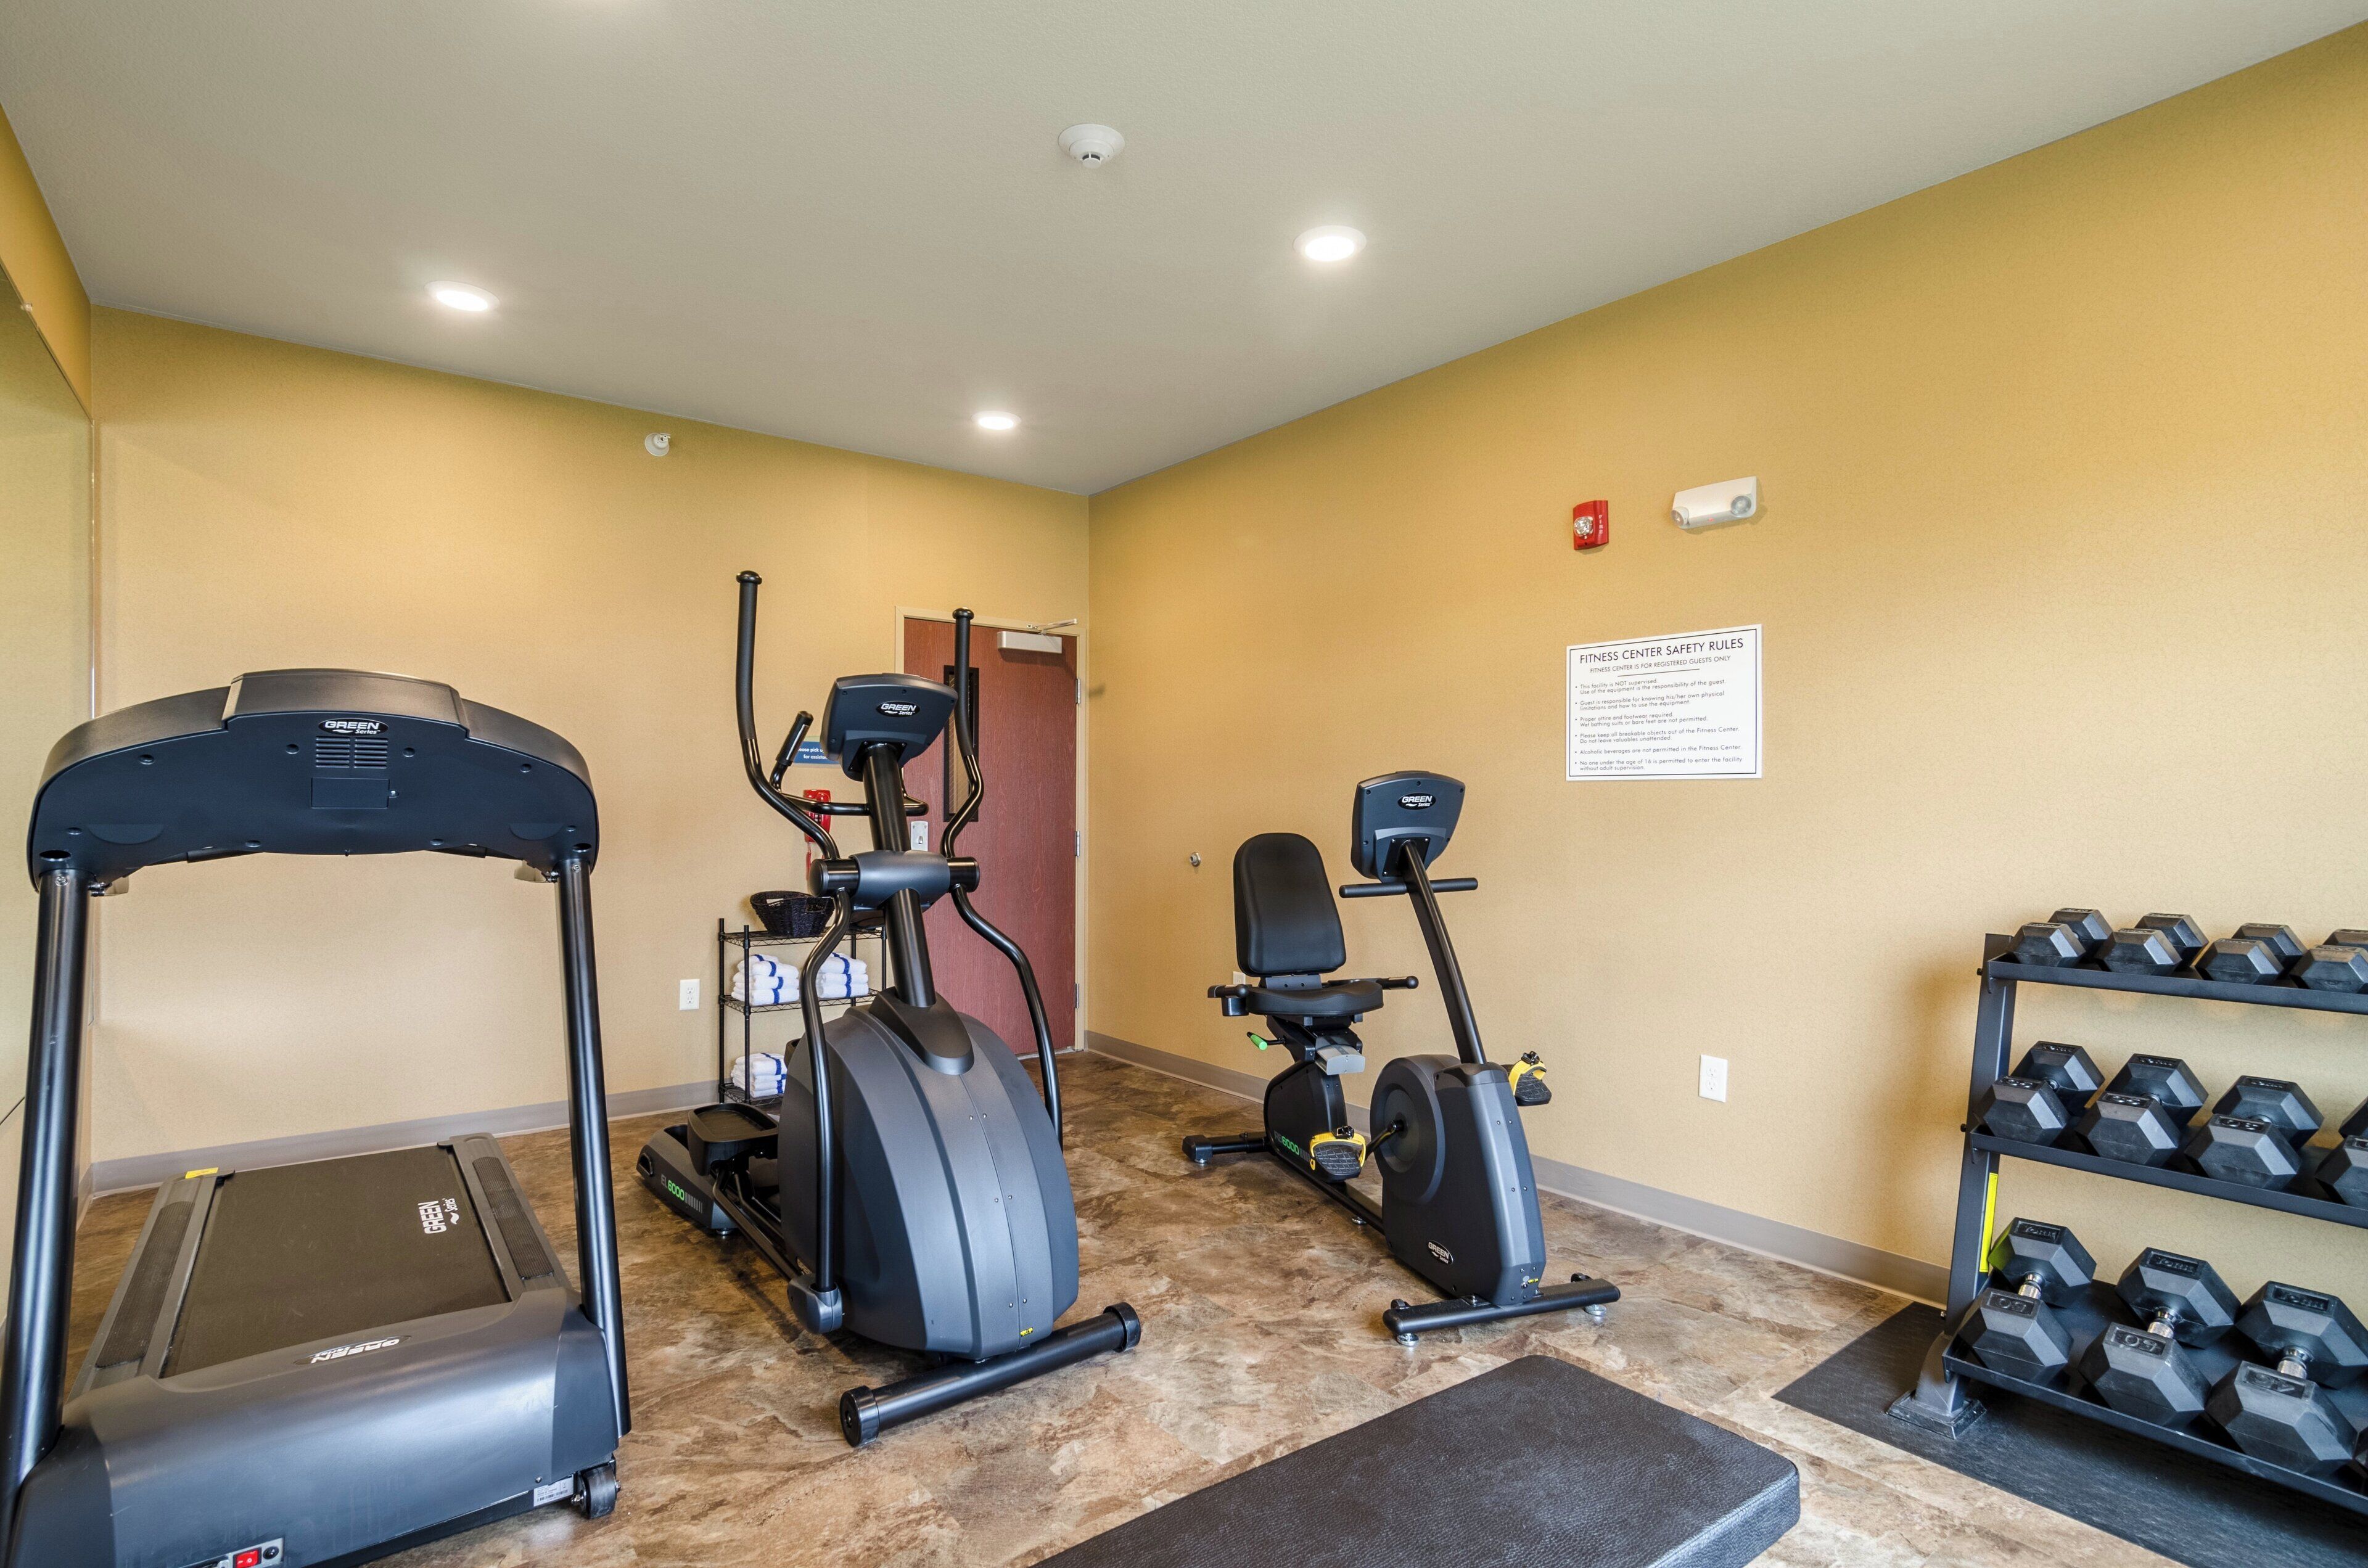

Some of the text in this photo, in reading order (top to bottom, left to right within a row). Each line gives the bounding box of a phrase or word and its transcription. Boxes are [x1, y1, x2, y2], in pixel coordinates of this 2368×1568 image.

[1580, 638, 1743, 663] FITNESS CENTER SAFETY RULES
[1654, 659, 1687, 667] REGISTERED
[881, 703, 916, 712] GREEN
[324, 721, 380, 730] GREEN
[444, 1198, 458, 1212] Series
[417, 1201, 447, 1234] GREEN
[1428, 1242, 1449, 1259] GREEN
[310, 1339, 400, 1364] GREEN
